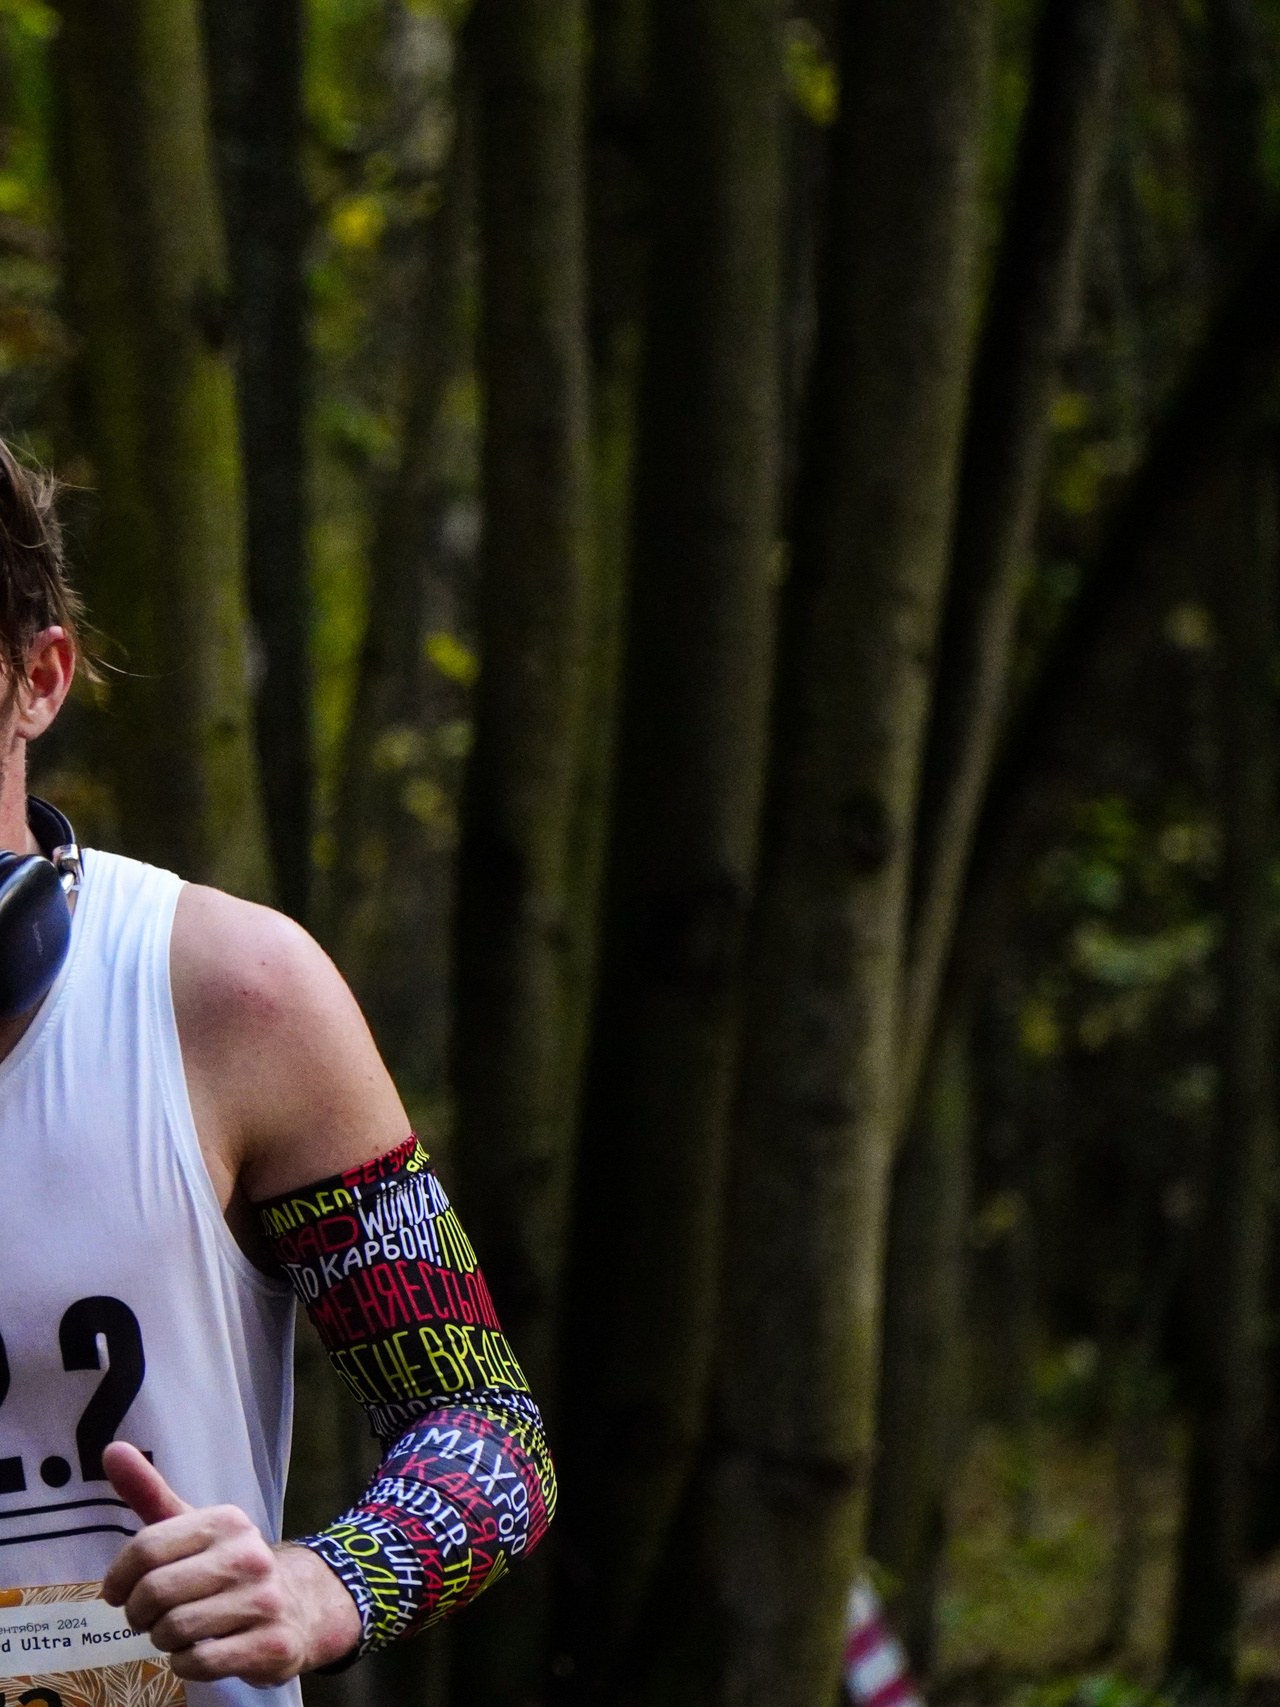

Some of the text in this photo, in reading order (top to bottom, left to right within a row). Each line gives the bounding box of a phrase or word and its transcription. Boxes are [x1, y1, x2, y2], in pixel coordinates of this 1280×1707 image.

[320, 1219, 442, 1288] КАРБОН!
[57, 1617, 88, 1631] 2024
[22, 1635, 72, 1651] Ultra
